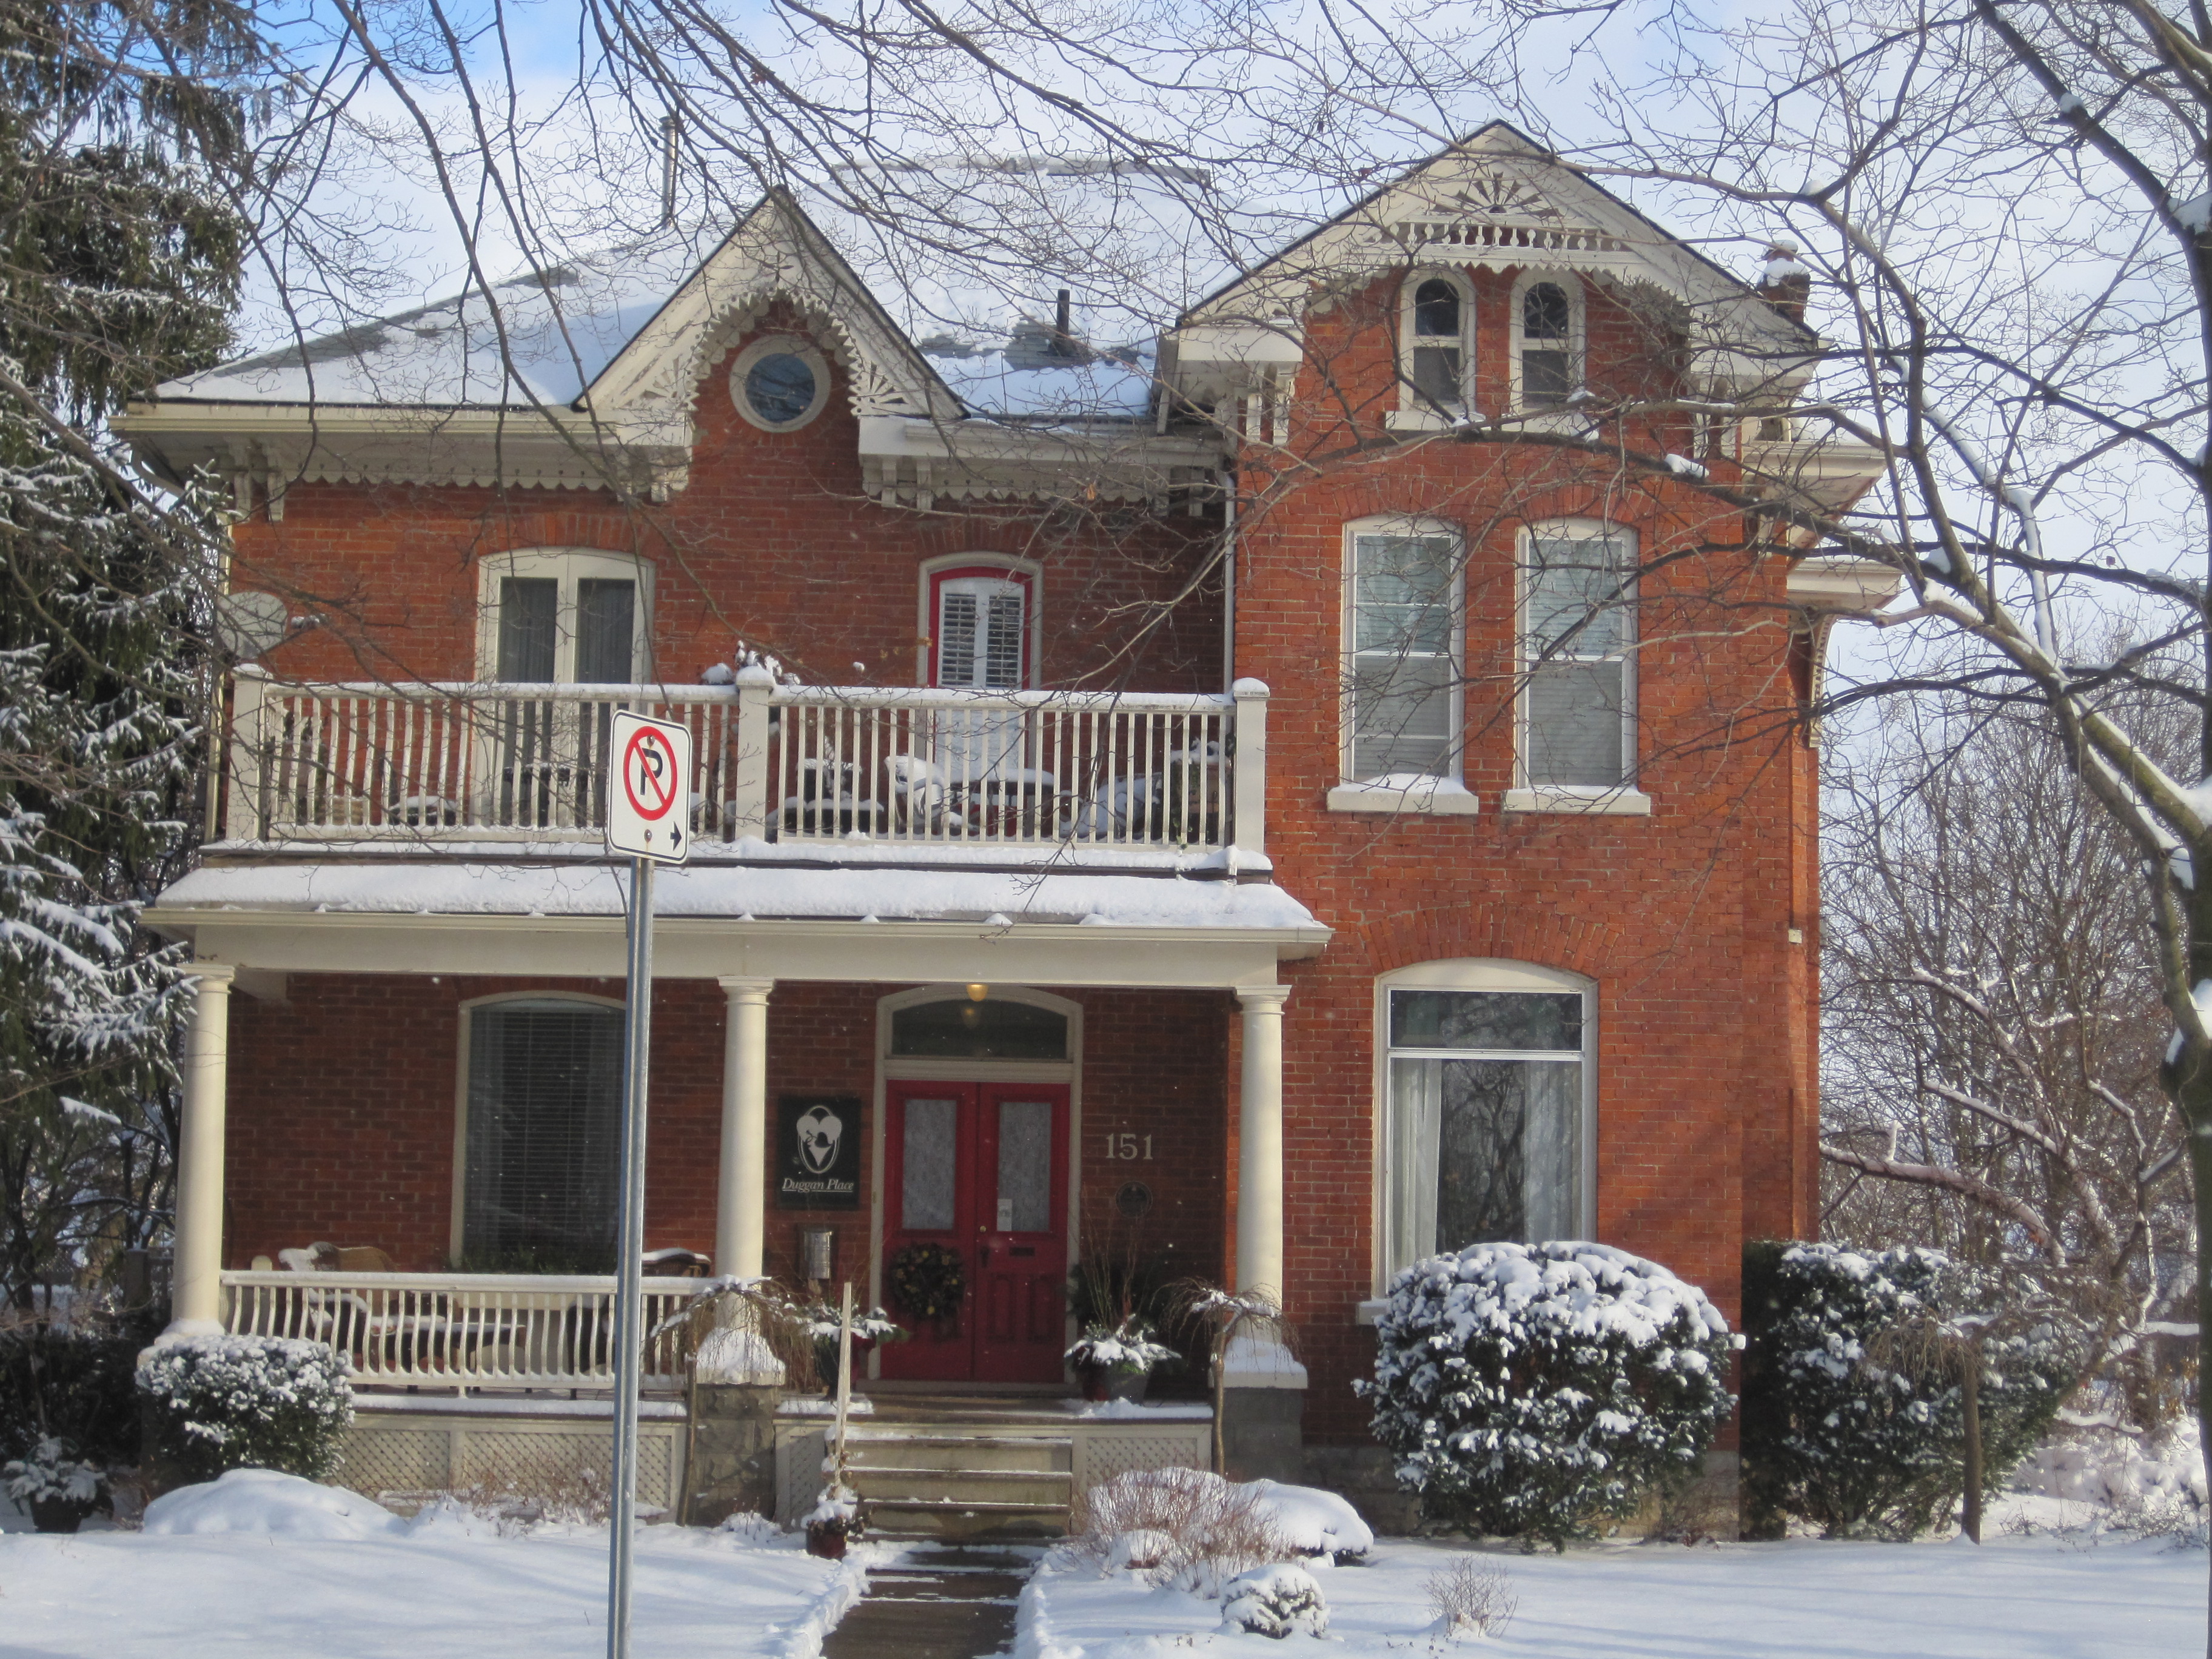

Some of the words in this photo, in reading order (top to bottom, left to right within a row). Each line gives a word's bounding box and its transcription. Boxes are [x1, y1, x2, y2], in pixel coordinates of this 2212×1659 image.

[640, 747, 663, 796] P
[1105, 1133, 1153, 1159] 151
[782, 1178, 823, 1193] Duggan
[826, 1179, 854, 1190] Place
